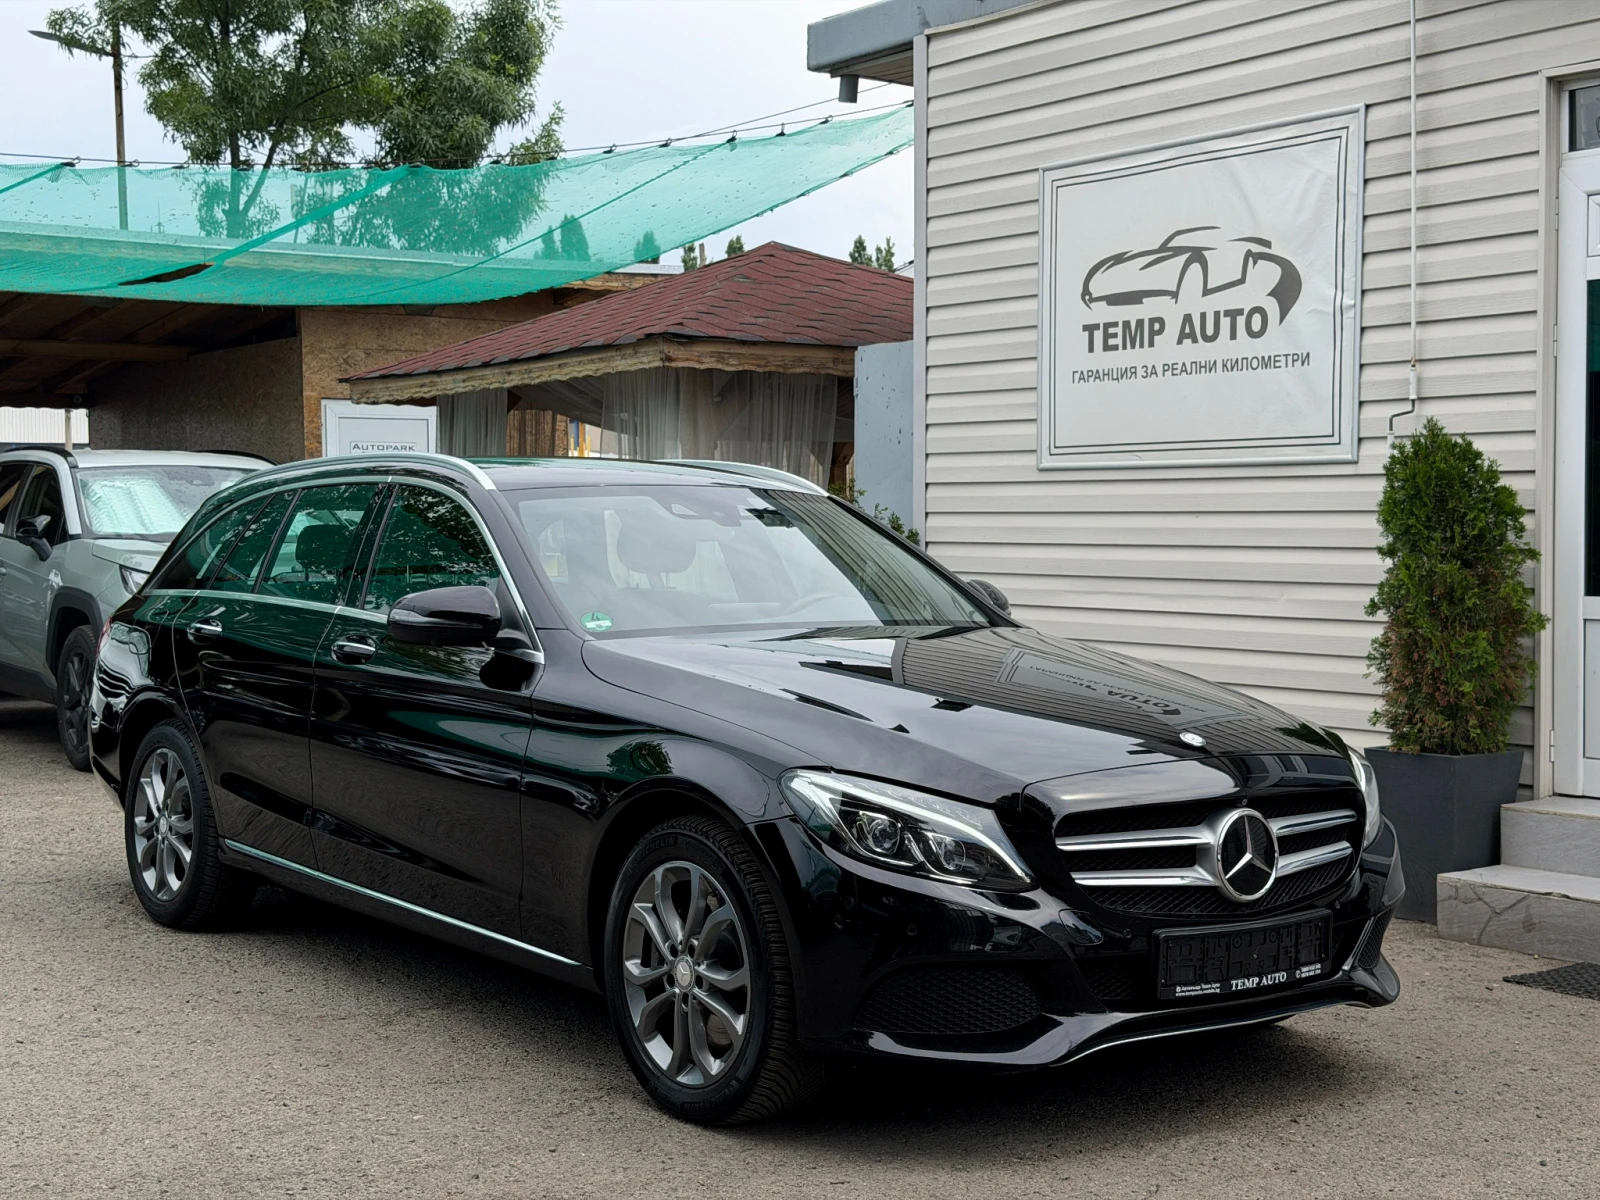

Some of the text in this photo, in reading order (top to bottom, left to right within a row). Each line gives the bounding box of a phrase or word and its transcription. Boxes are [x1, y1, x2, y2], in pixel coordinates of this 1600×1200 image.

[1082, 305, 1269, 354] TEMP AUTO
[1072, 351, 1311, 384] ГАРАНЦИЯ ЗА РЕАЛНИ КИЛОМЕТРИ
[352, 443, 416, 452] AUTOPARK
[1231, 977, 1259, 991] TEMP
[1261, 971, 1287, 987] AUTO
